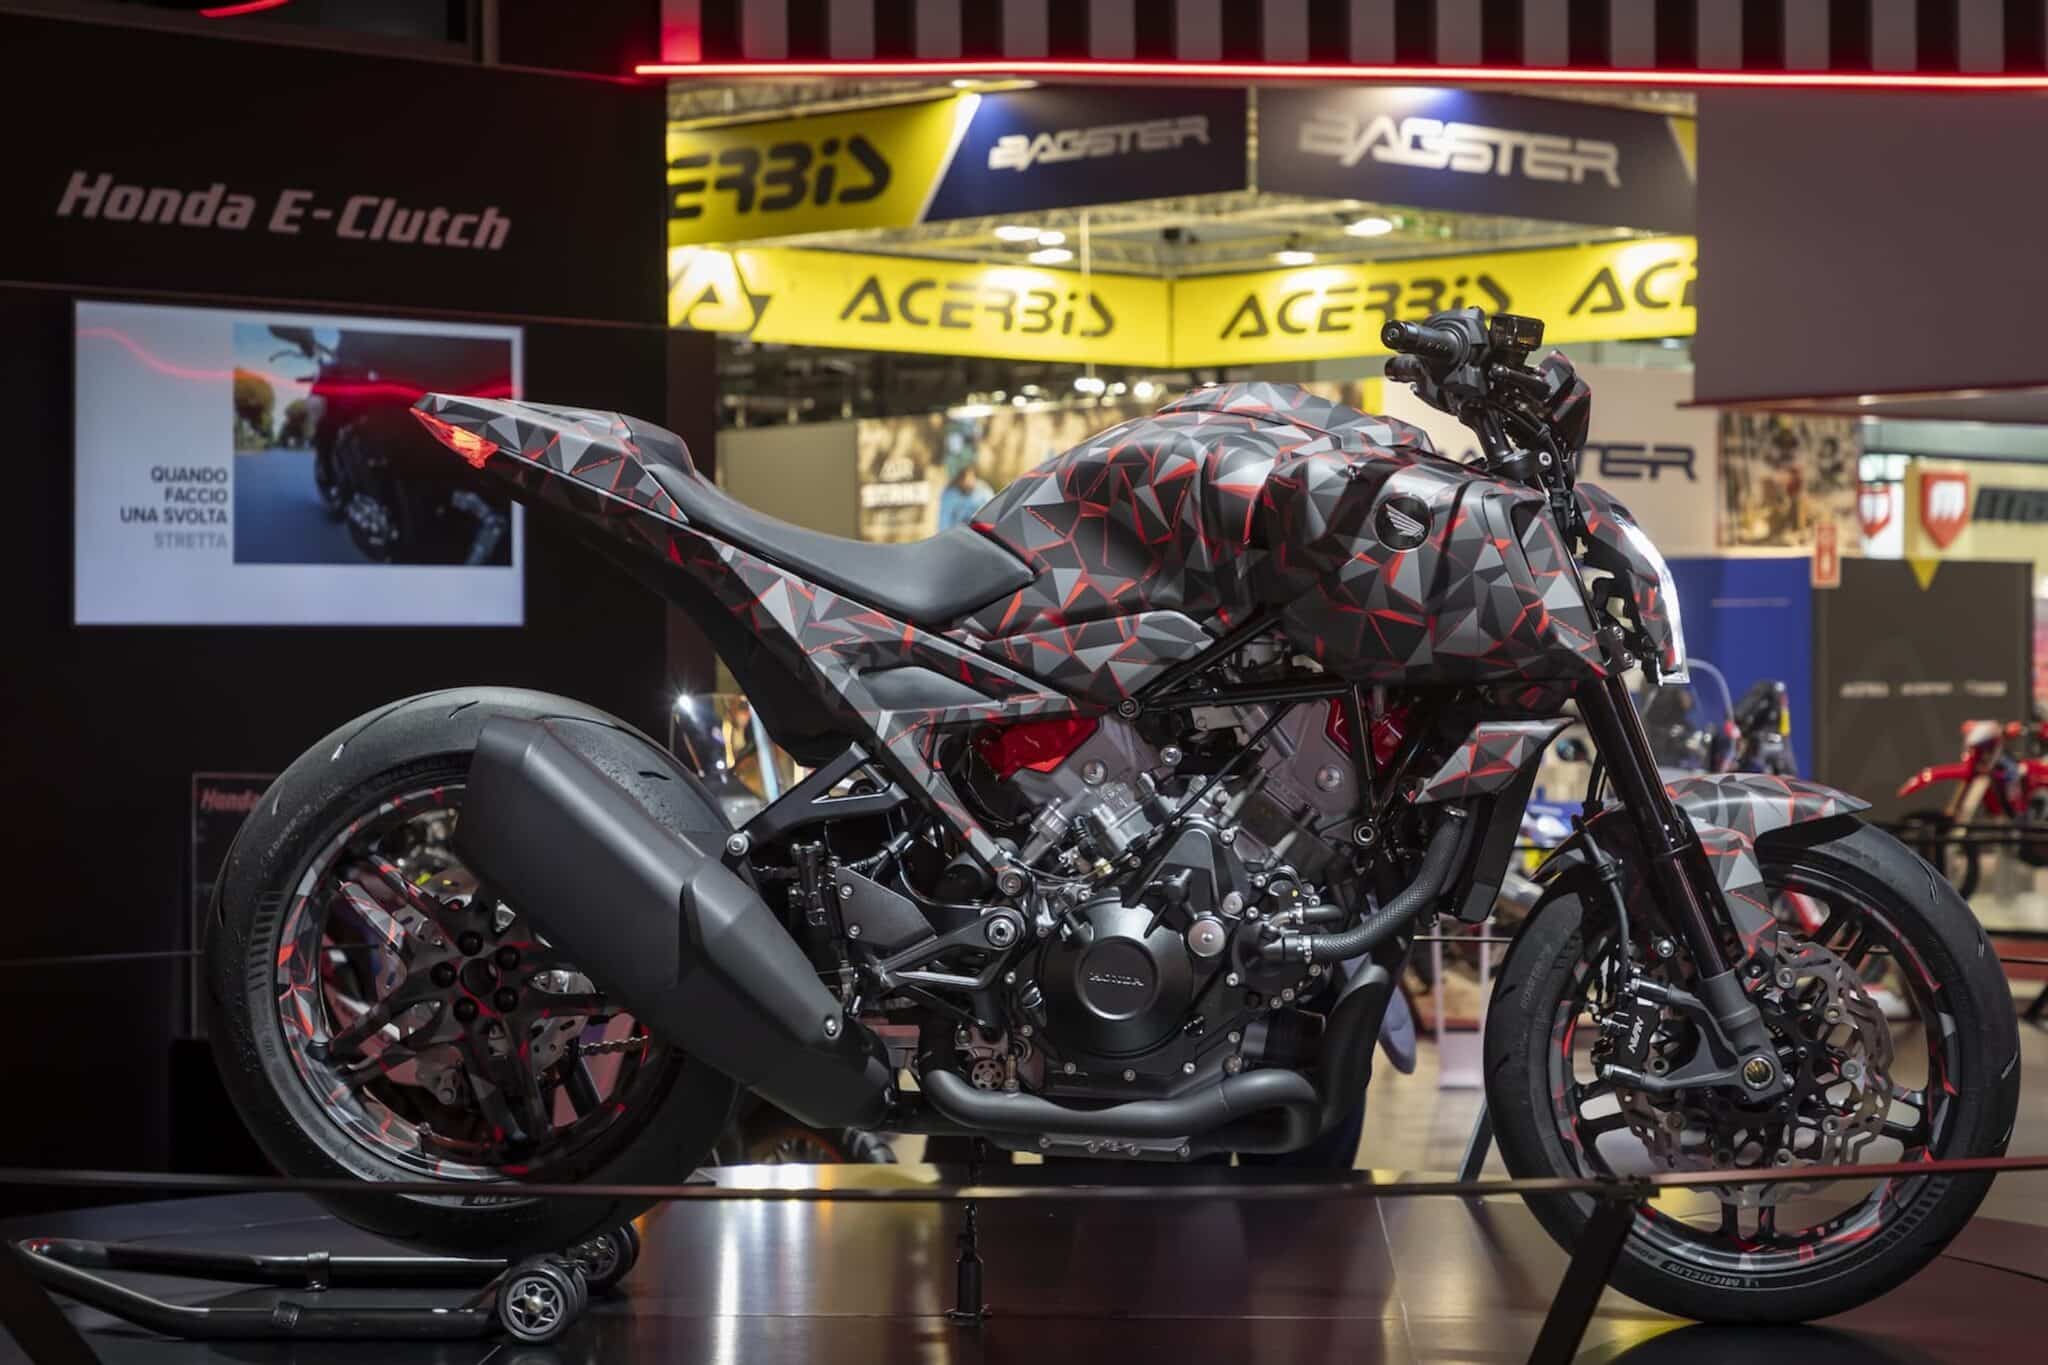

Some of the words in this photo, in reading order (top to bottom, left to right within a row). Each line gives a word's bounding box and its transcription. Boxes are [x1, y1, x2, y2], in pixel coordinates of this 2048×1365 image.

[988, 114, 1210, 172] BAGSTER
[1299, 104, 1622, 188] BAGSTER
[56, 169, 257, 230] Honda
[268, 188, 511, 250] E-Clutch
[1567, 257, 1697, 316] AC
[151, 465, 228, 484] QUANDO
[164, 486, 228, 505] FACCIO
[119, 505, 159, 524] UNA
[163, 505, 228, 525] SVOLTA
[153, 530, 228, 550] STRETTA
[1668, 1261, 1740, 1288] MICHELIN
